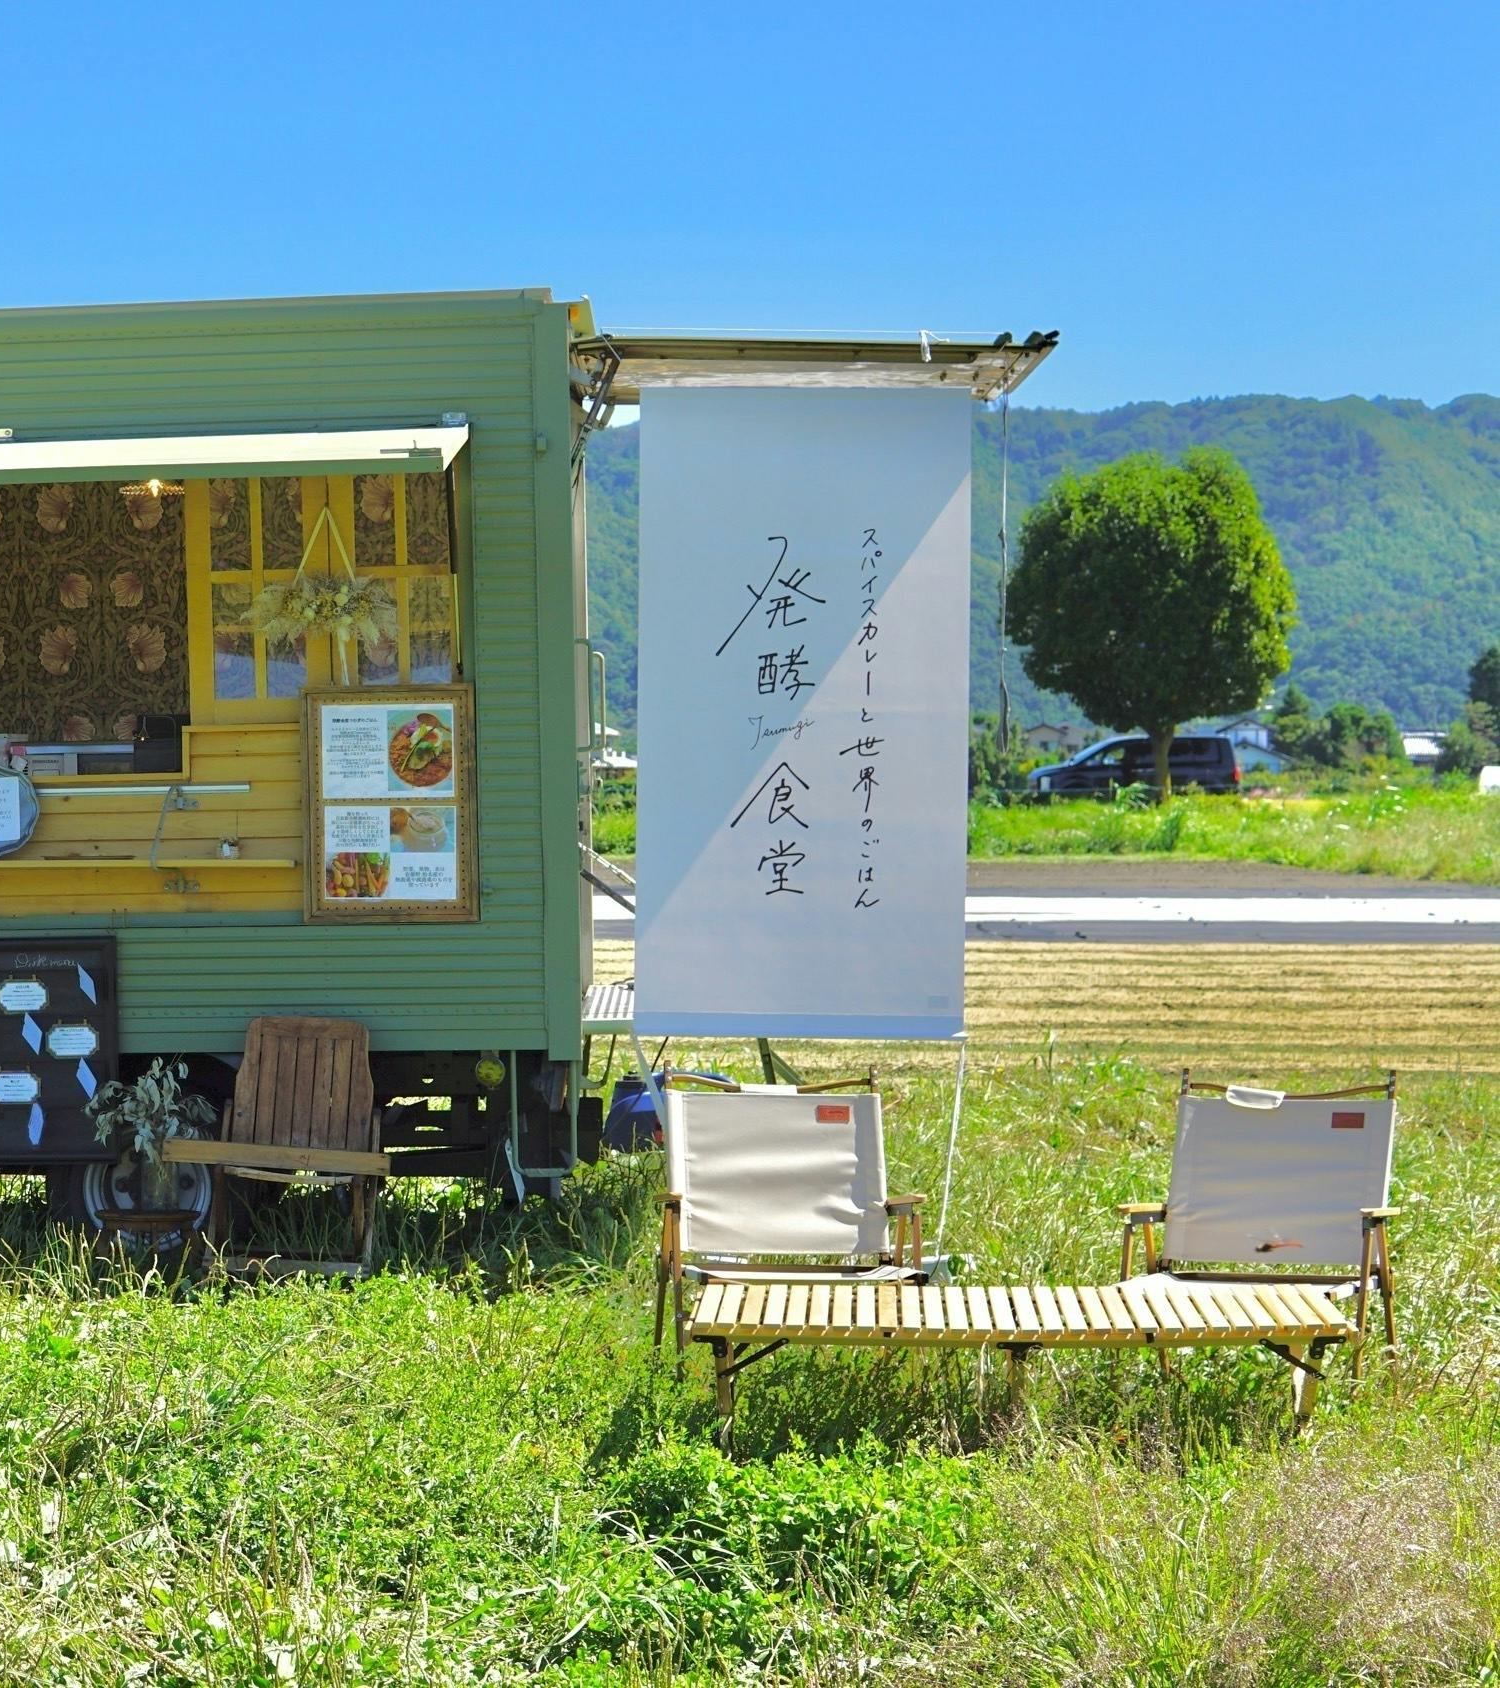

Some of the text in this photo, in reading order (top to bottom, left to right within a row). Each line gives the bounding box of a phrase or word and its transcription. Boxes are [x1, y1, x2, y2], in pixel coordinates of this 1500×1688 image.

[715, 535, 827, 897] 発酵食堂
[838, 527, 883, 910] スパイスカレーと世界のごはん
